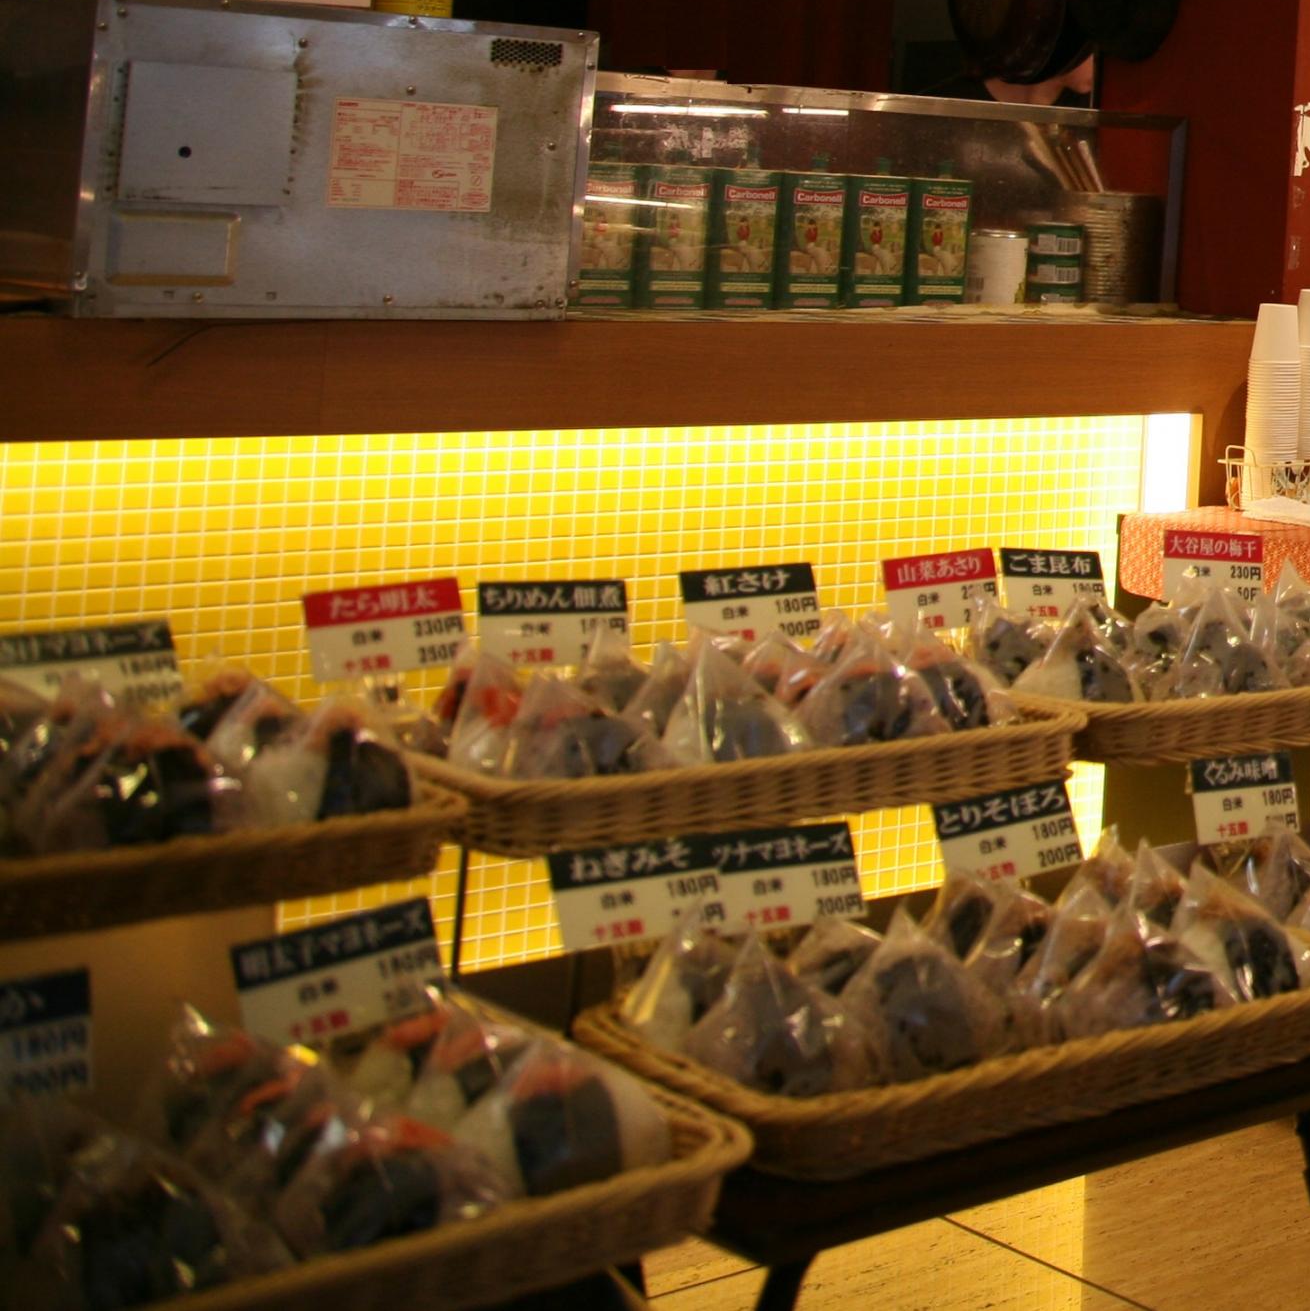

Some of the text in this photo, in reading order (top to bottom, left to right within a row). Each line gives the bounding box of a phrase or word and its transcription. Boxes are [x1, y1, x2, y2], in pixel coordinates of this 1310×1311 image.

[729, 189, 775, 201] Carbonell
[797, 192, 843, 204] Carbonell
[862, 194, 907, 206] Carbonell
[926, 197, 967, 209] Carbonell
[1009, 554, 1091, 574] ごま昆布
[704, 570, 790, 595] 紅さけ
[329, 585, 438, 618] たら明太
[939, 786, 1065, 834] とりそぼろ
[569, 831, 850, 882] ねぎみそ ツナマヨネーズ
